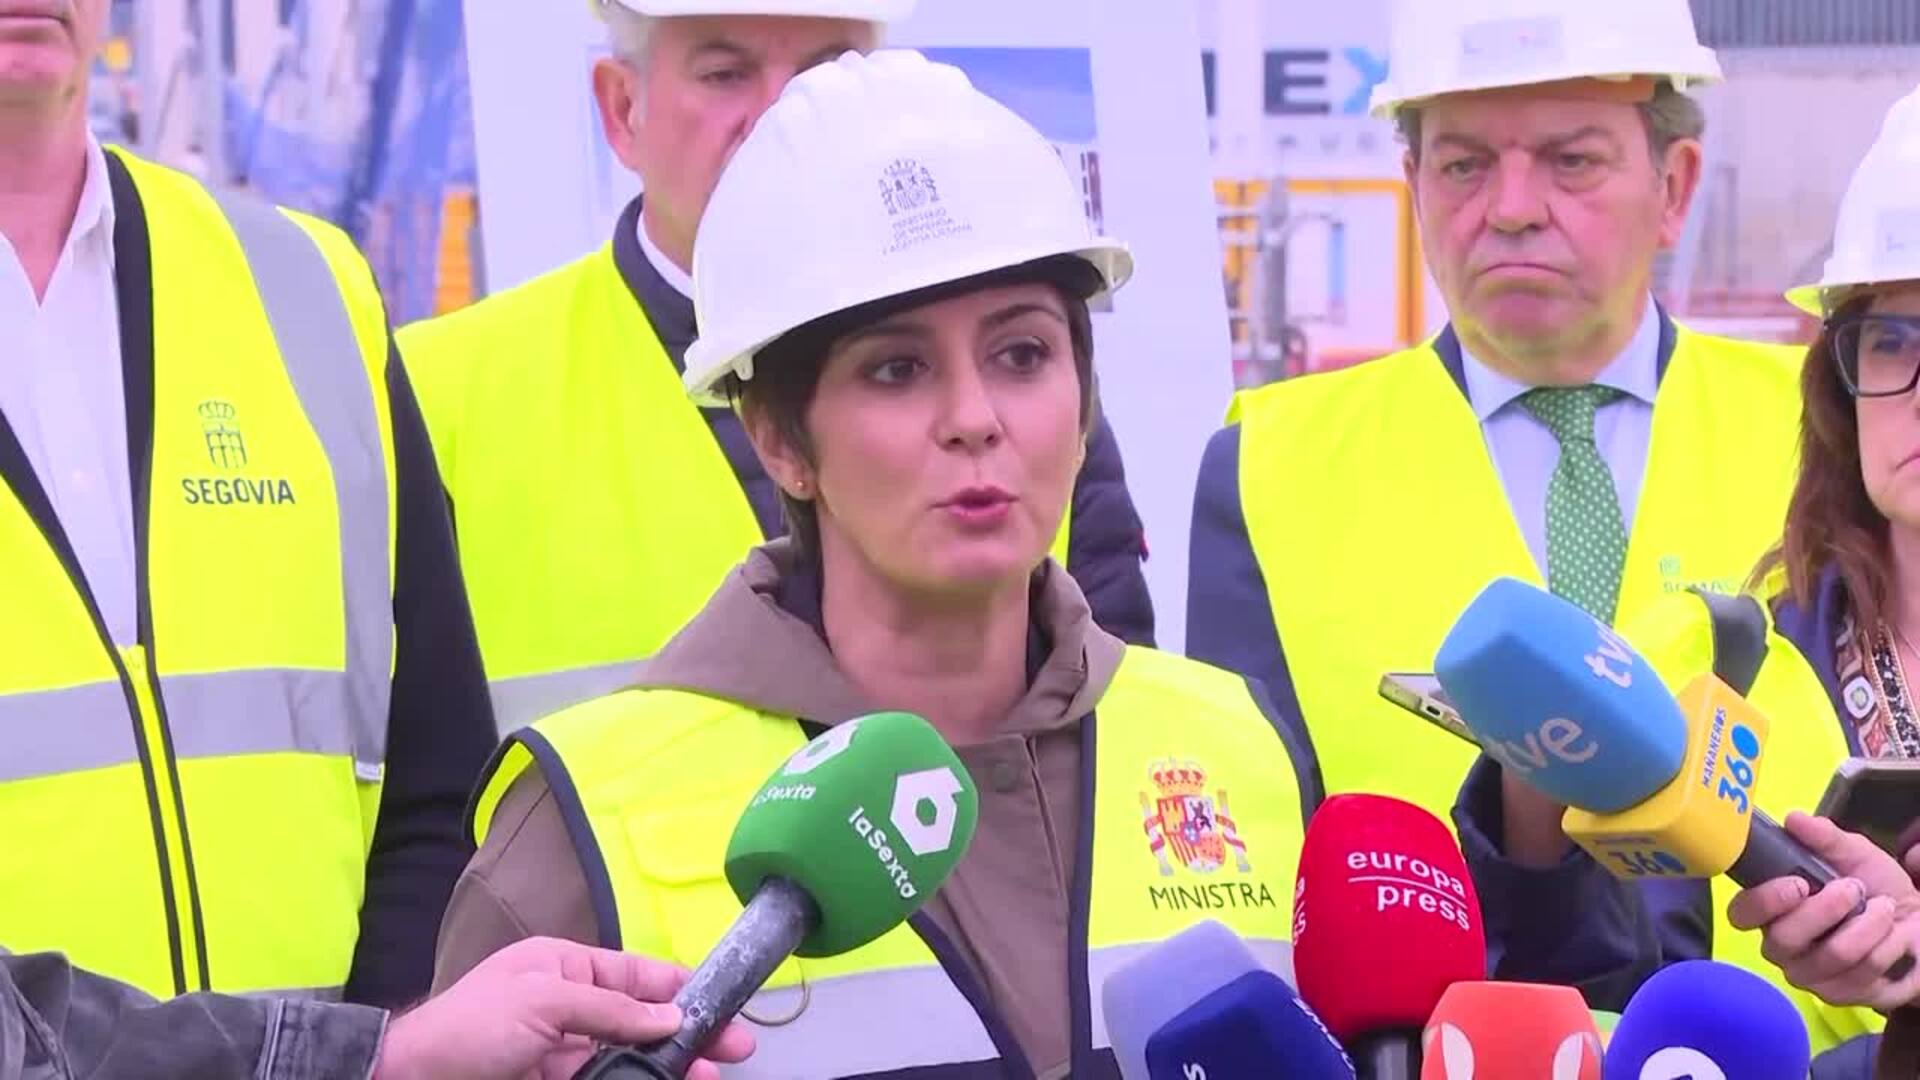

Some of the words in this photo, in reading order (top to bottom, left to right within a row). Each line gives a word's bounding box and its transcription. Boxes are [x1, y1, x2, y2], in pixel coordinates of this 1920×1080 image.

[181, 477, 296, 505] SEGOVIA
[1717, 723, 1759, 814] 360
[848, 805, 918, 898] laSexta
[1347, 851, 1466, 899] europa
[1148, 882, 1277, 911] MINISTRA
[1377, 885, 1470, 932] press
